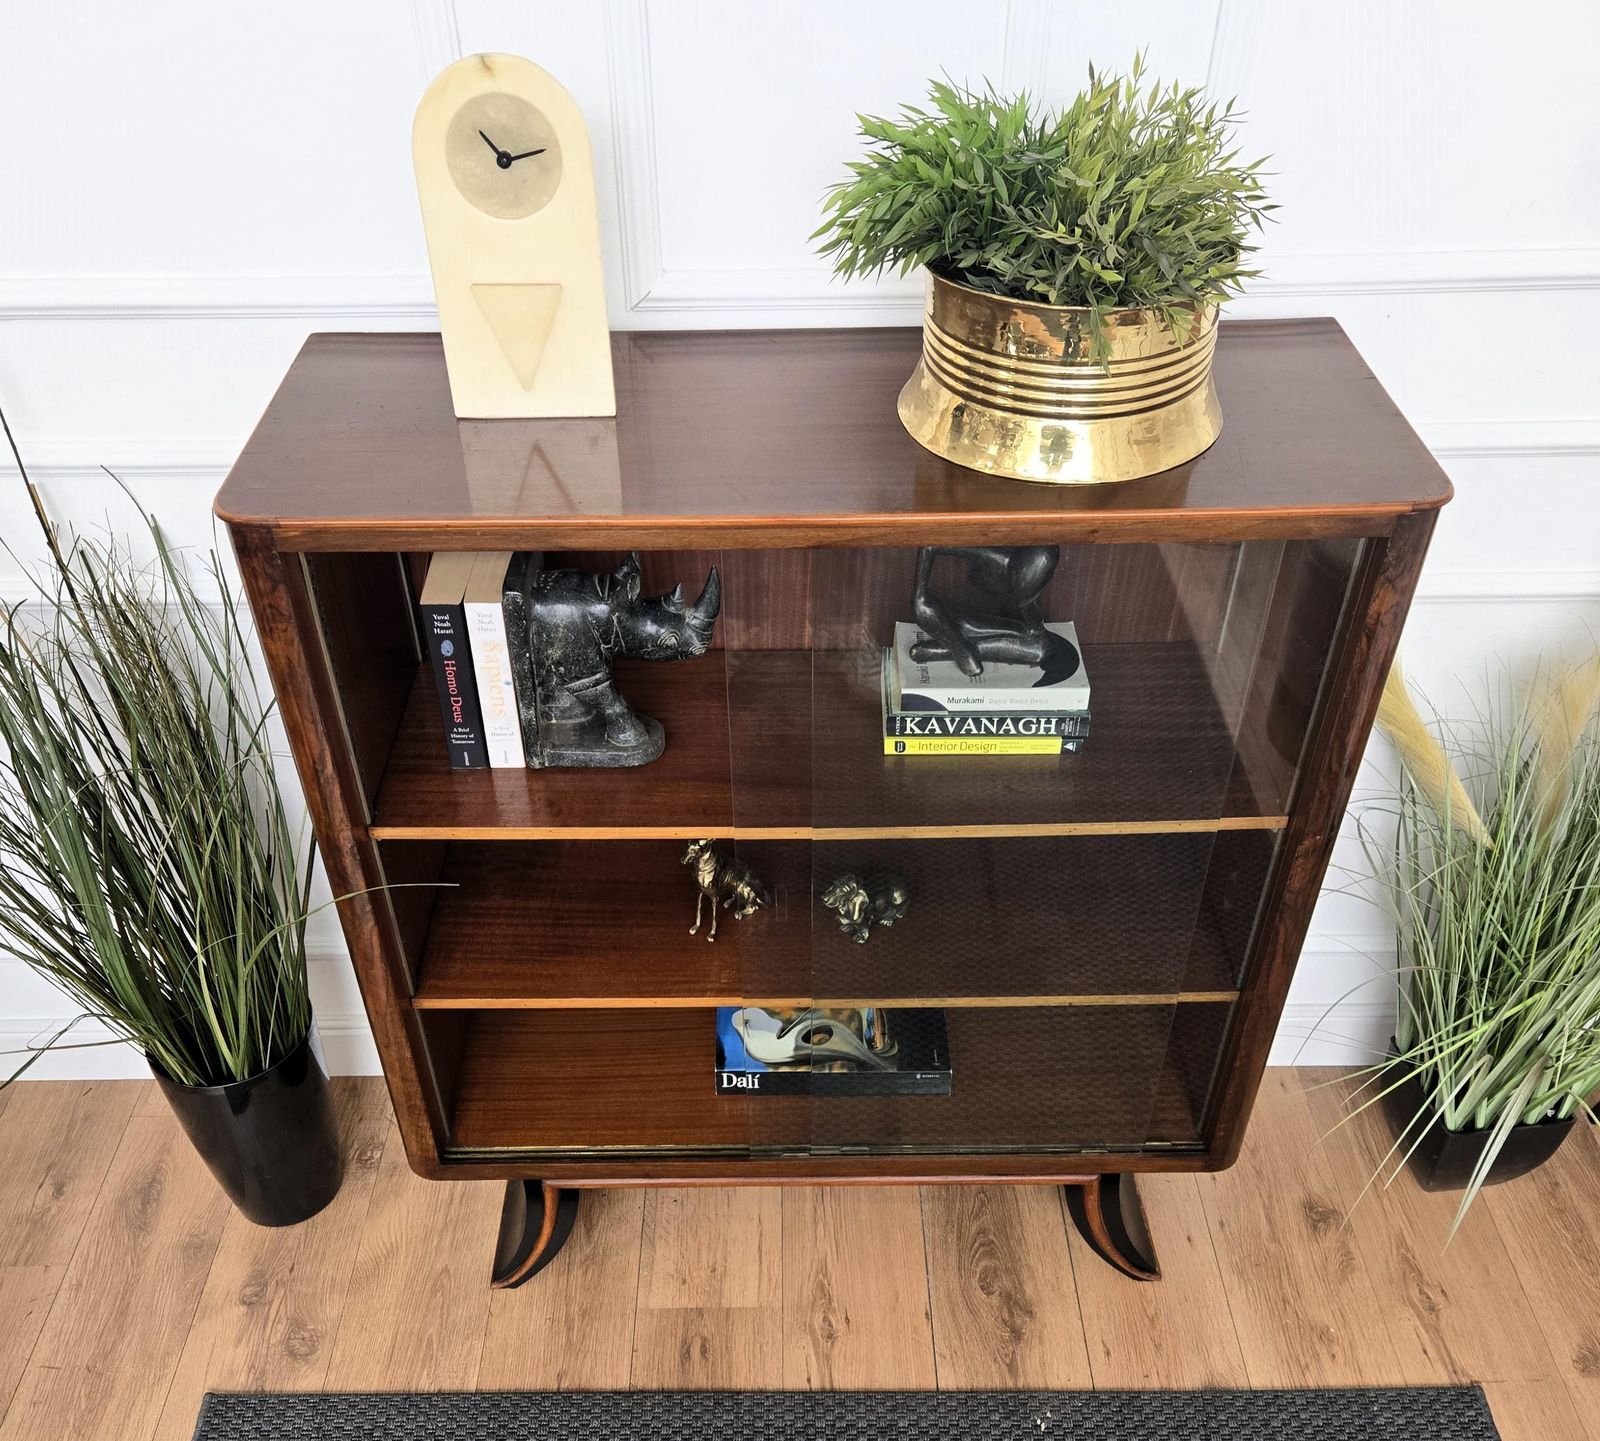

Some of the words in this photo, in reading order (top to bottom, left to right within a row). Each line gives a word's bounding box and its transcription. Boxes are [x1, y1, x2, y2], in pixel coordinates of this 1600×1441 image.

[433, 613, 450, 621] Yuval
[443, 660, 458, 695] Homo
[480, 642, 506, 717] Sapiens
[450, 697, 463, 723] Deus
[904, 717, 1059, 735] KAVANAGH
[918, 742, 959, 751] Interior
[960, 742, 997, 754] Design
[721, 1073, 761, 1089] Dalí
